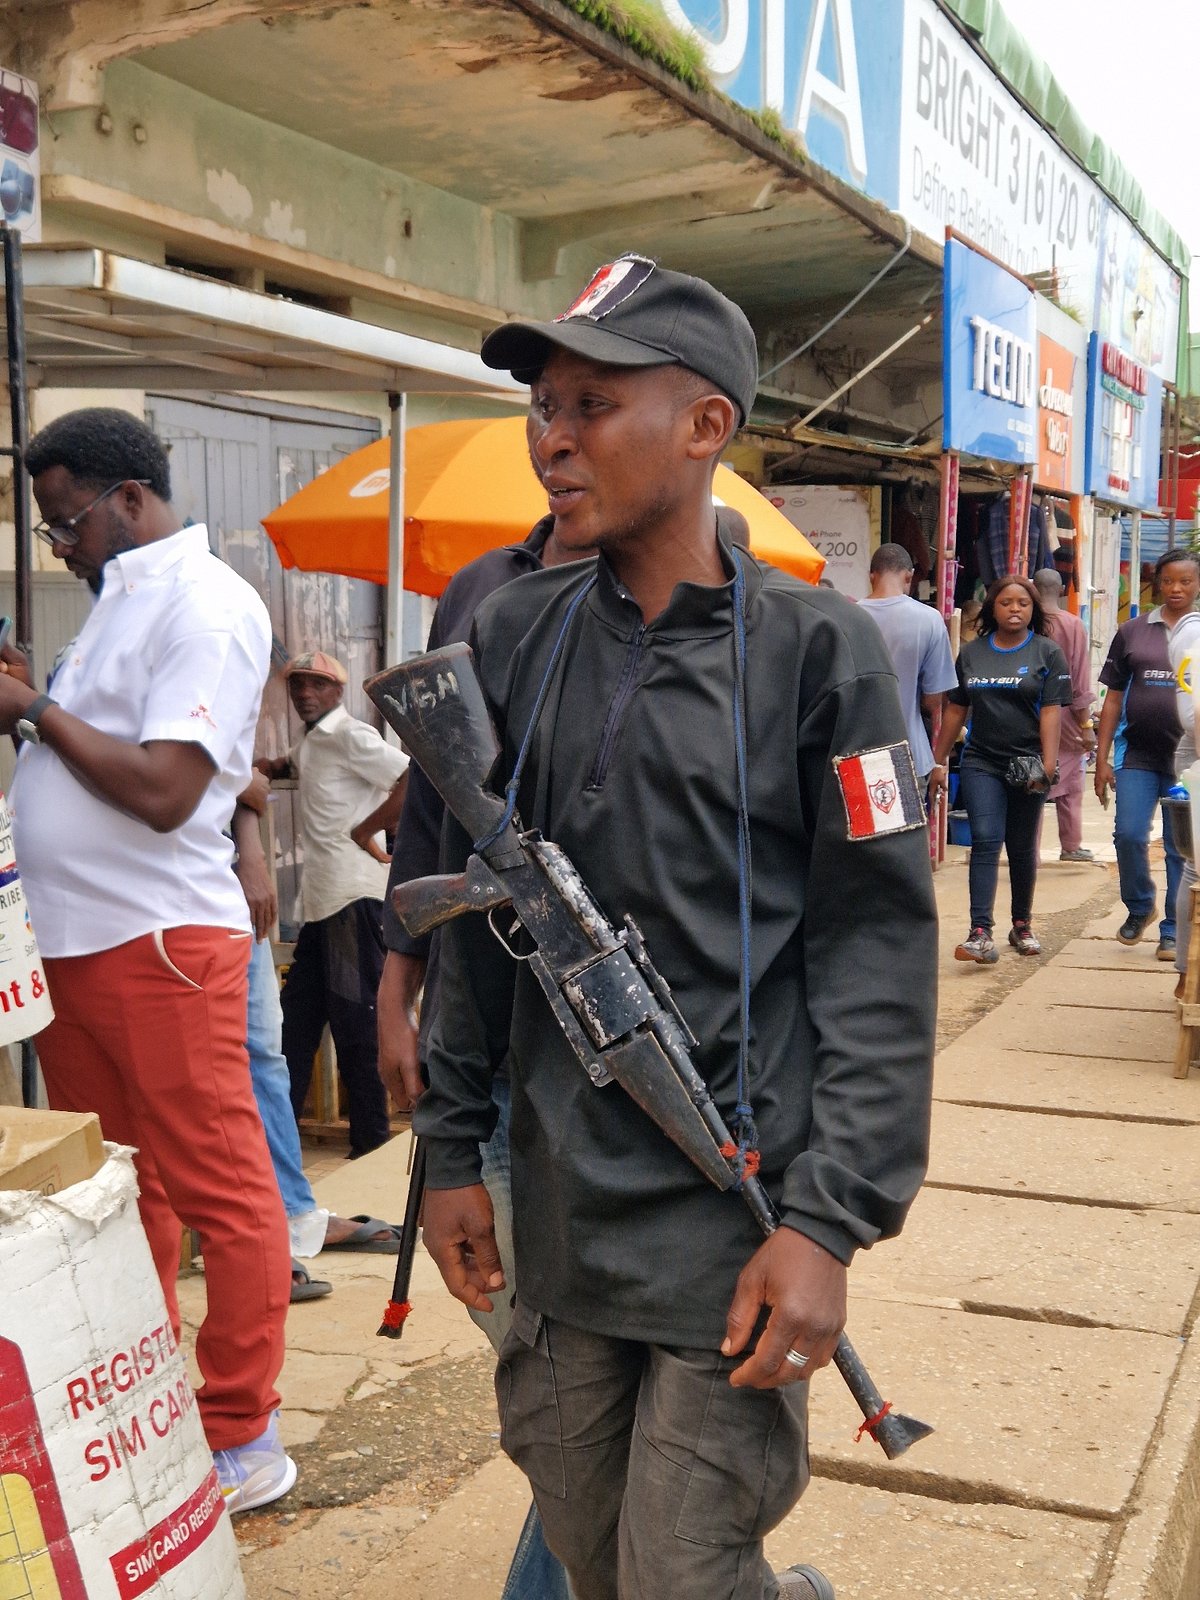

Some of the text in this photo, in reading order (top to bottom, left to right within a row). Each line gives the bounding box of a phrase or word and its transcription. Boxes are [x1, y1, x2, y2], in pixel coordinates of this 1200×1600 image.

[916, 17, 1005, 187] BRIGHT
[912, 145, 956, 226] Define
[970, 315, 1033, 409] TECNO
[825, 541, 858, 557] 200
[1144, 670, 1176, 679] EASY
[31, 969, 45, 999] &
[84, 1415, 147, 1482] SIM
[125, 1549, 156, 1582] SIM
[153, 1521, 190, 1561] CARD
